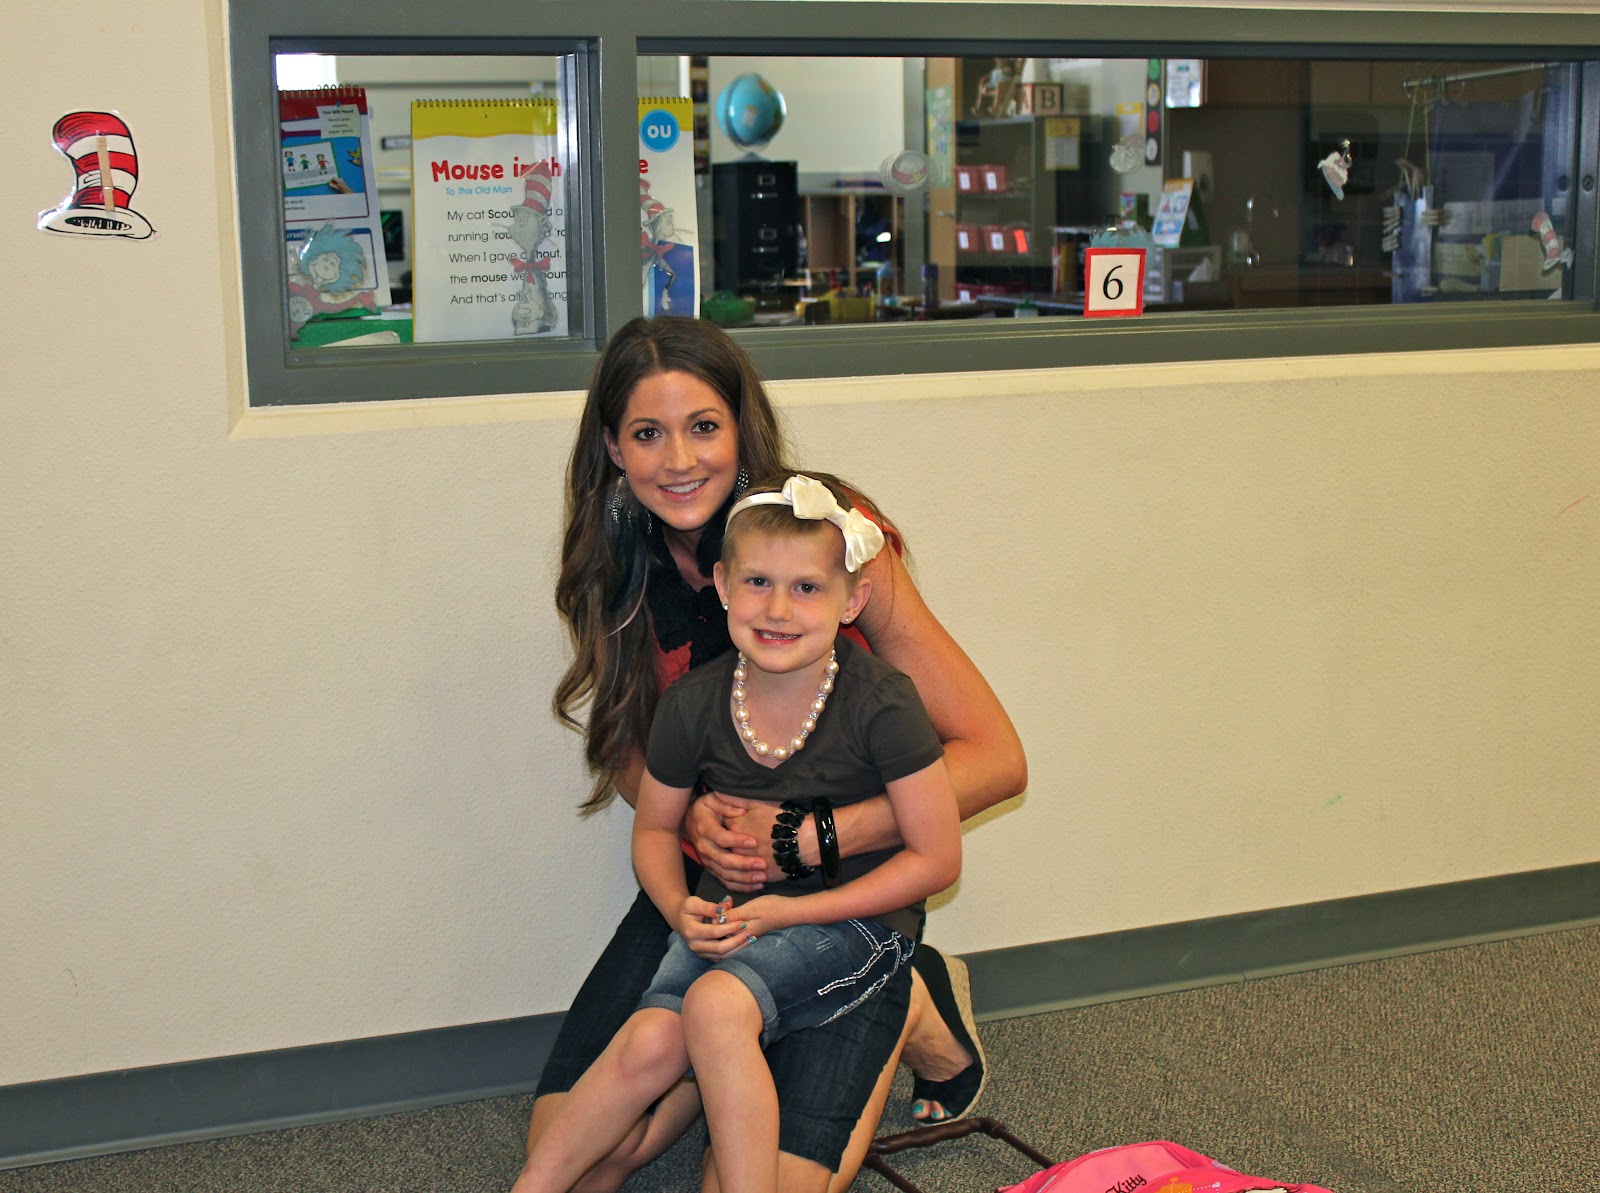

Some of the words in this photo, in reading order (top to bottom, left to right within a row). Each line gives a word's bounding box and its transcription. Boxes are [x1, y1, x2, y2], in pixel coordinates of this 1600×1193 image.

[1040, 87, 1056, 109] B
[431, 160, 504, 182] Mouse
[446, 188, 455, 196] To
[458, 187, 473, 195] This
[475, 186, 490, 194] Old
[493, 186, 512, 194] Man
[447, 211, 464, 222] My
[466, 210, 485, 220] cat
[488, 209, 516, 219] Scou
[448, 231, 489, 243] running
[449, 252, 481, 263] When
[489, 251, 518, 264] gave
[535, 248, 562, 259] hout,
[450, 274, 468, 284] the
[471, 273, 508, 283] mouse
[1102, 264, 1124, 301] 6
[450, 294, 473, 305] And
[476, 293, 506, 303] that's
[1105, 1174, 1148, 1193] Kitty
